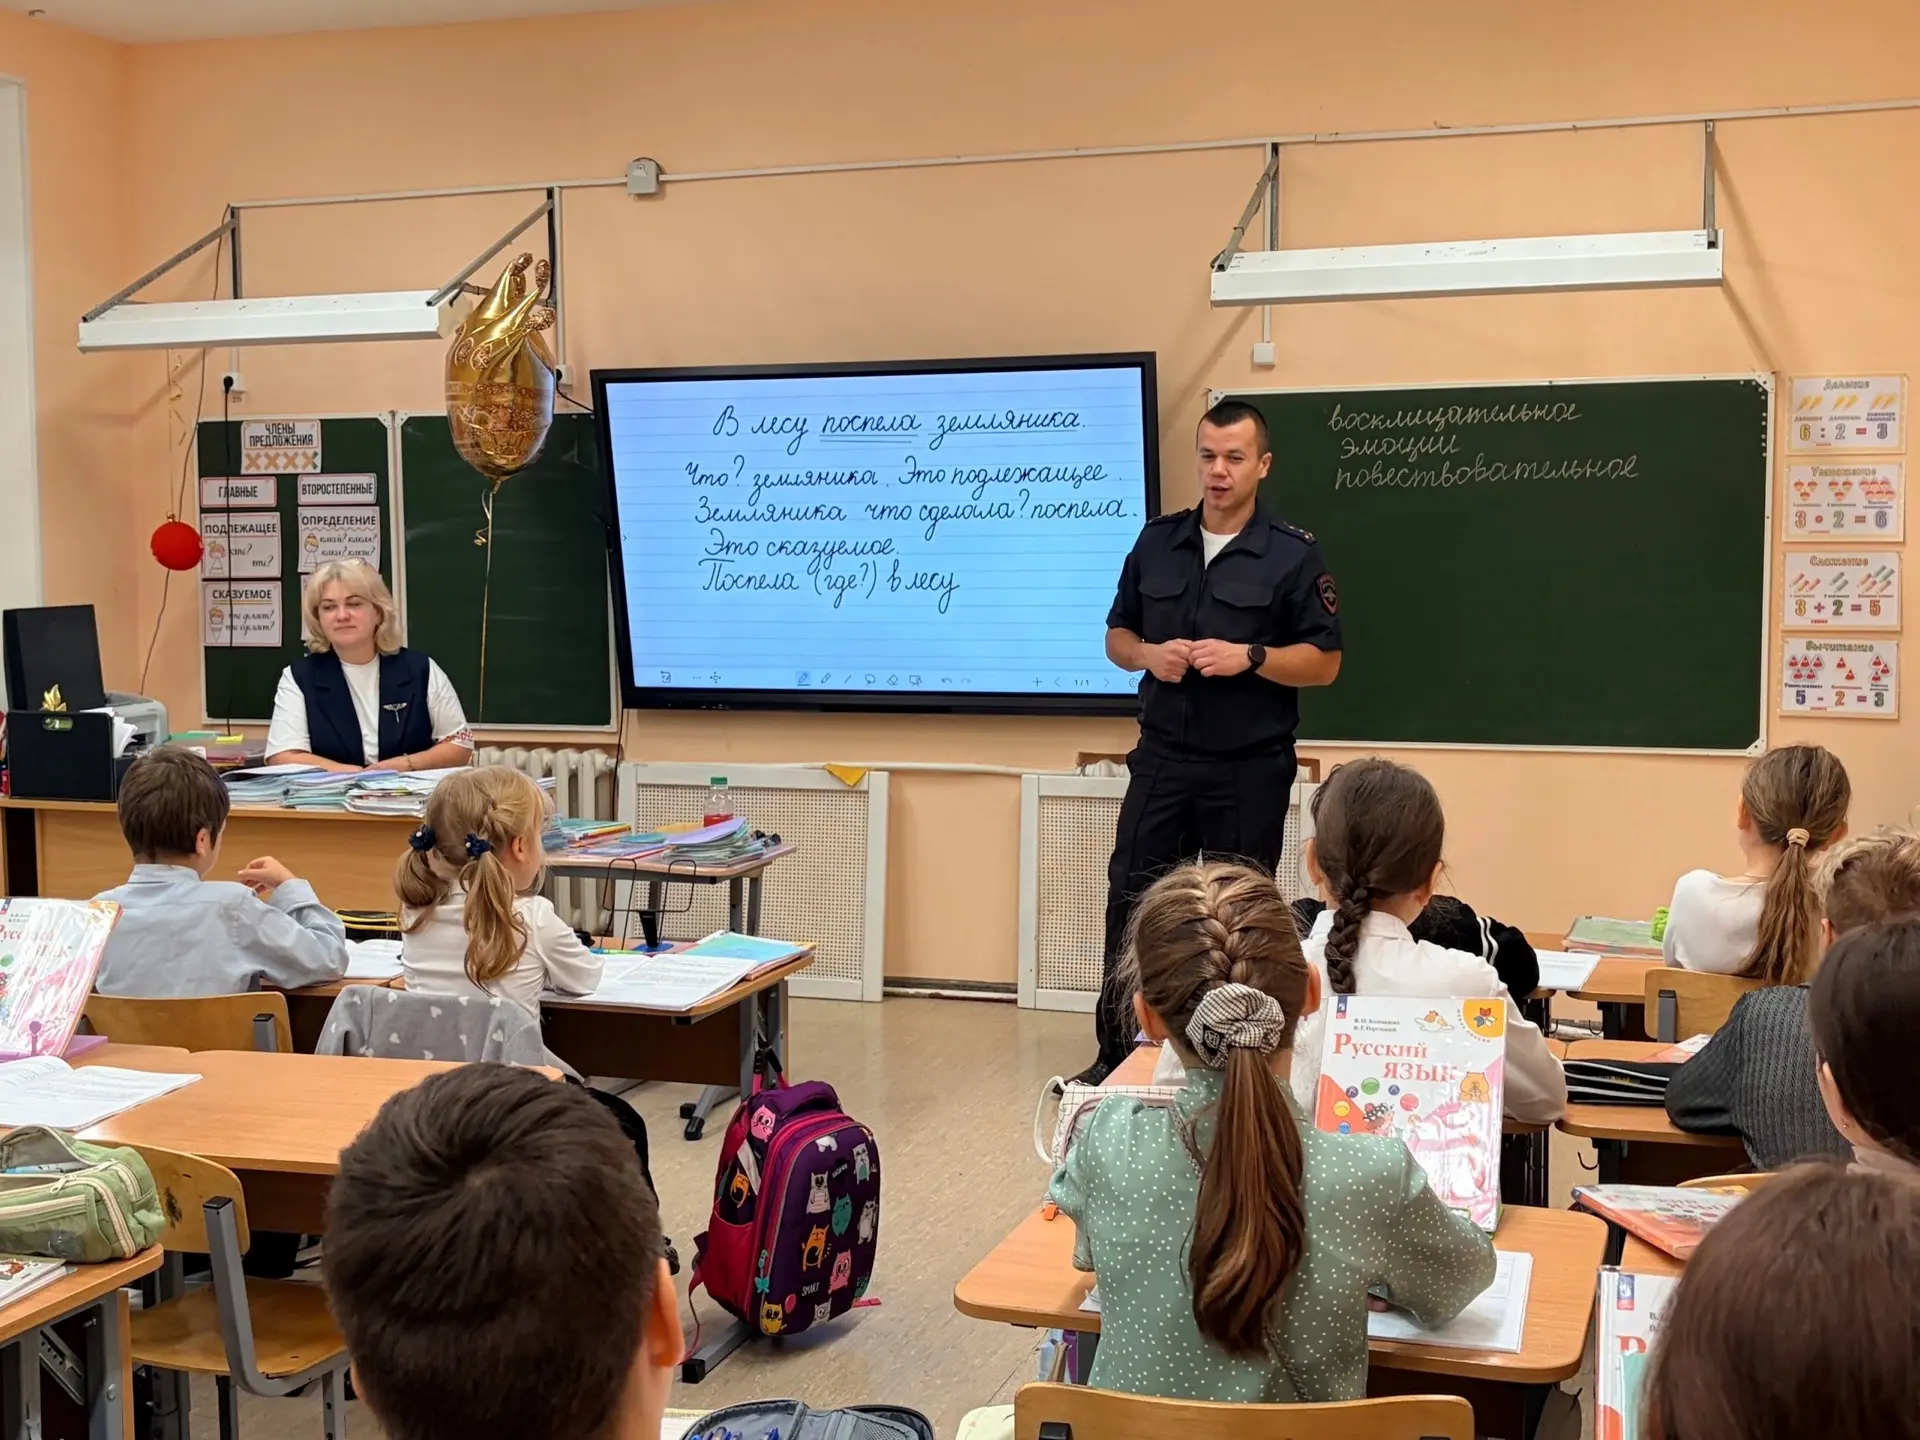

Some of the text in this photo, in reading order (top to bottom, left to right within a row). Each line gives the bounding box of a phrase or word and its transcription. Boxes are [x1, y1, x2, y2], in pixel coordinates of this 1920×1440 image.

[1327, 402, 1583, 432] восклицательное
[265, 423, 296, 435] ЧЛЕНЫ
[713, 405, 1086, 456] В лесу поспела земляника.
[1800, 424, 1811, 441] 6
[1835, 423, 1846, 440] 2
[1876, 422, 1888, 440] 3
[249, 434, 314, 448] ПРЕДЛОЖЕНИЯ
[1340, 435, 1461, 462] эмоции
[685, 455, 745, 487] Что?
[898, 455, 946, 484] Это
[1335, 453, 1639, 490] повествовательное
[218, 486, 258, 498] ГЛАВНЫЕ
[301, 483, 373, 496] ВТОРОСТЕПЕННЫЕ
[695, 495, 847, 524] Земляника
[864, 504, 913, 521] что
[1030, 498, 1137, 520] поспела.
[205, 523, 277, 535] ПОДЛЕЖАЩЕЕ
[301, 515, 376, 527] ОПРЕДЕЛЕНИЕ
[1795, 510, 1807, 528] 3
[1833, 510, 1844, 528] 2
[1875, 510, 1887, 529] 6
[705, 528, 900, 576] Это сказуемое.
[212, 589, 272, 599] СКАЗУЕМОЕ
[698, 558, 960, 614] Поспела (где?) в лесу
[1795, 599, 1806, 617] 3
[1832, 599, 1843, 616] 2
[1869, 599, 1881, 617] 5
[1074, 679, 1090, 687] 1/1
[1796, 689, 1806, 706] 5
[1834, 690, 1846, 707] 2
[1874, 691, 1885, 708] 3
[1332, 1033, 1427, 1059] Русский
[801, 1282, 821, 1297] SMART
